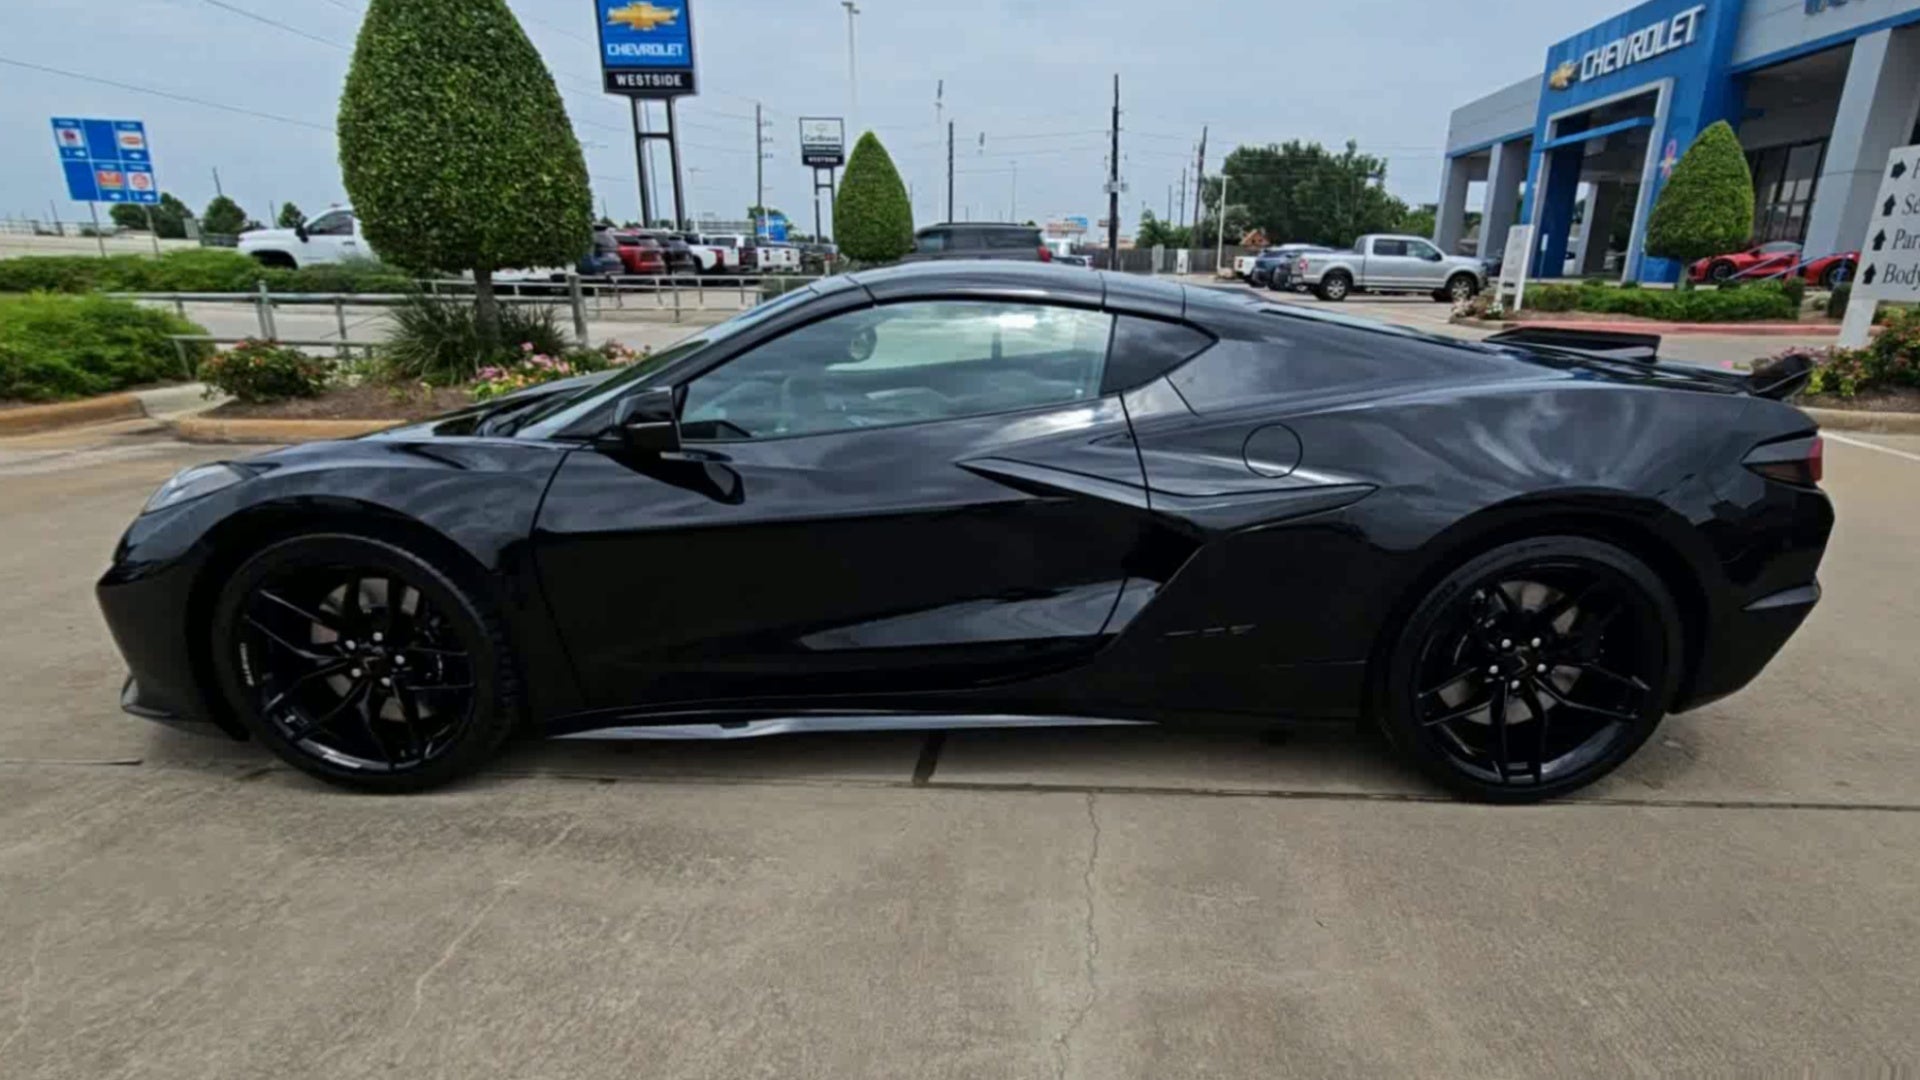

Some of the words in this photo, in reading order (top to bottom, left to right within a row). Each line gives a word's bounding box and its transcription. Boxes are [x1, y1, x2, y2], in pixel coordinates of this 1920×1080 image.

[607, 43, 684, 56] CHEVROLET
[1580, 4, 1705, 82] CHEVROLET
[615, 74, 682, 86] WESTSIDE
